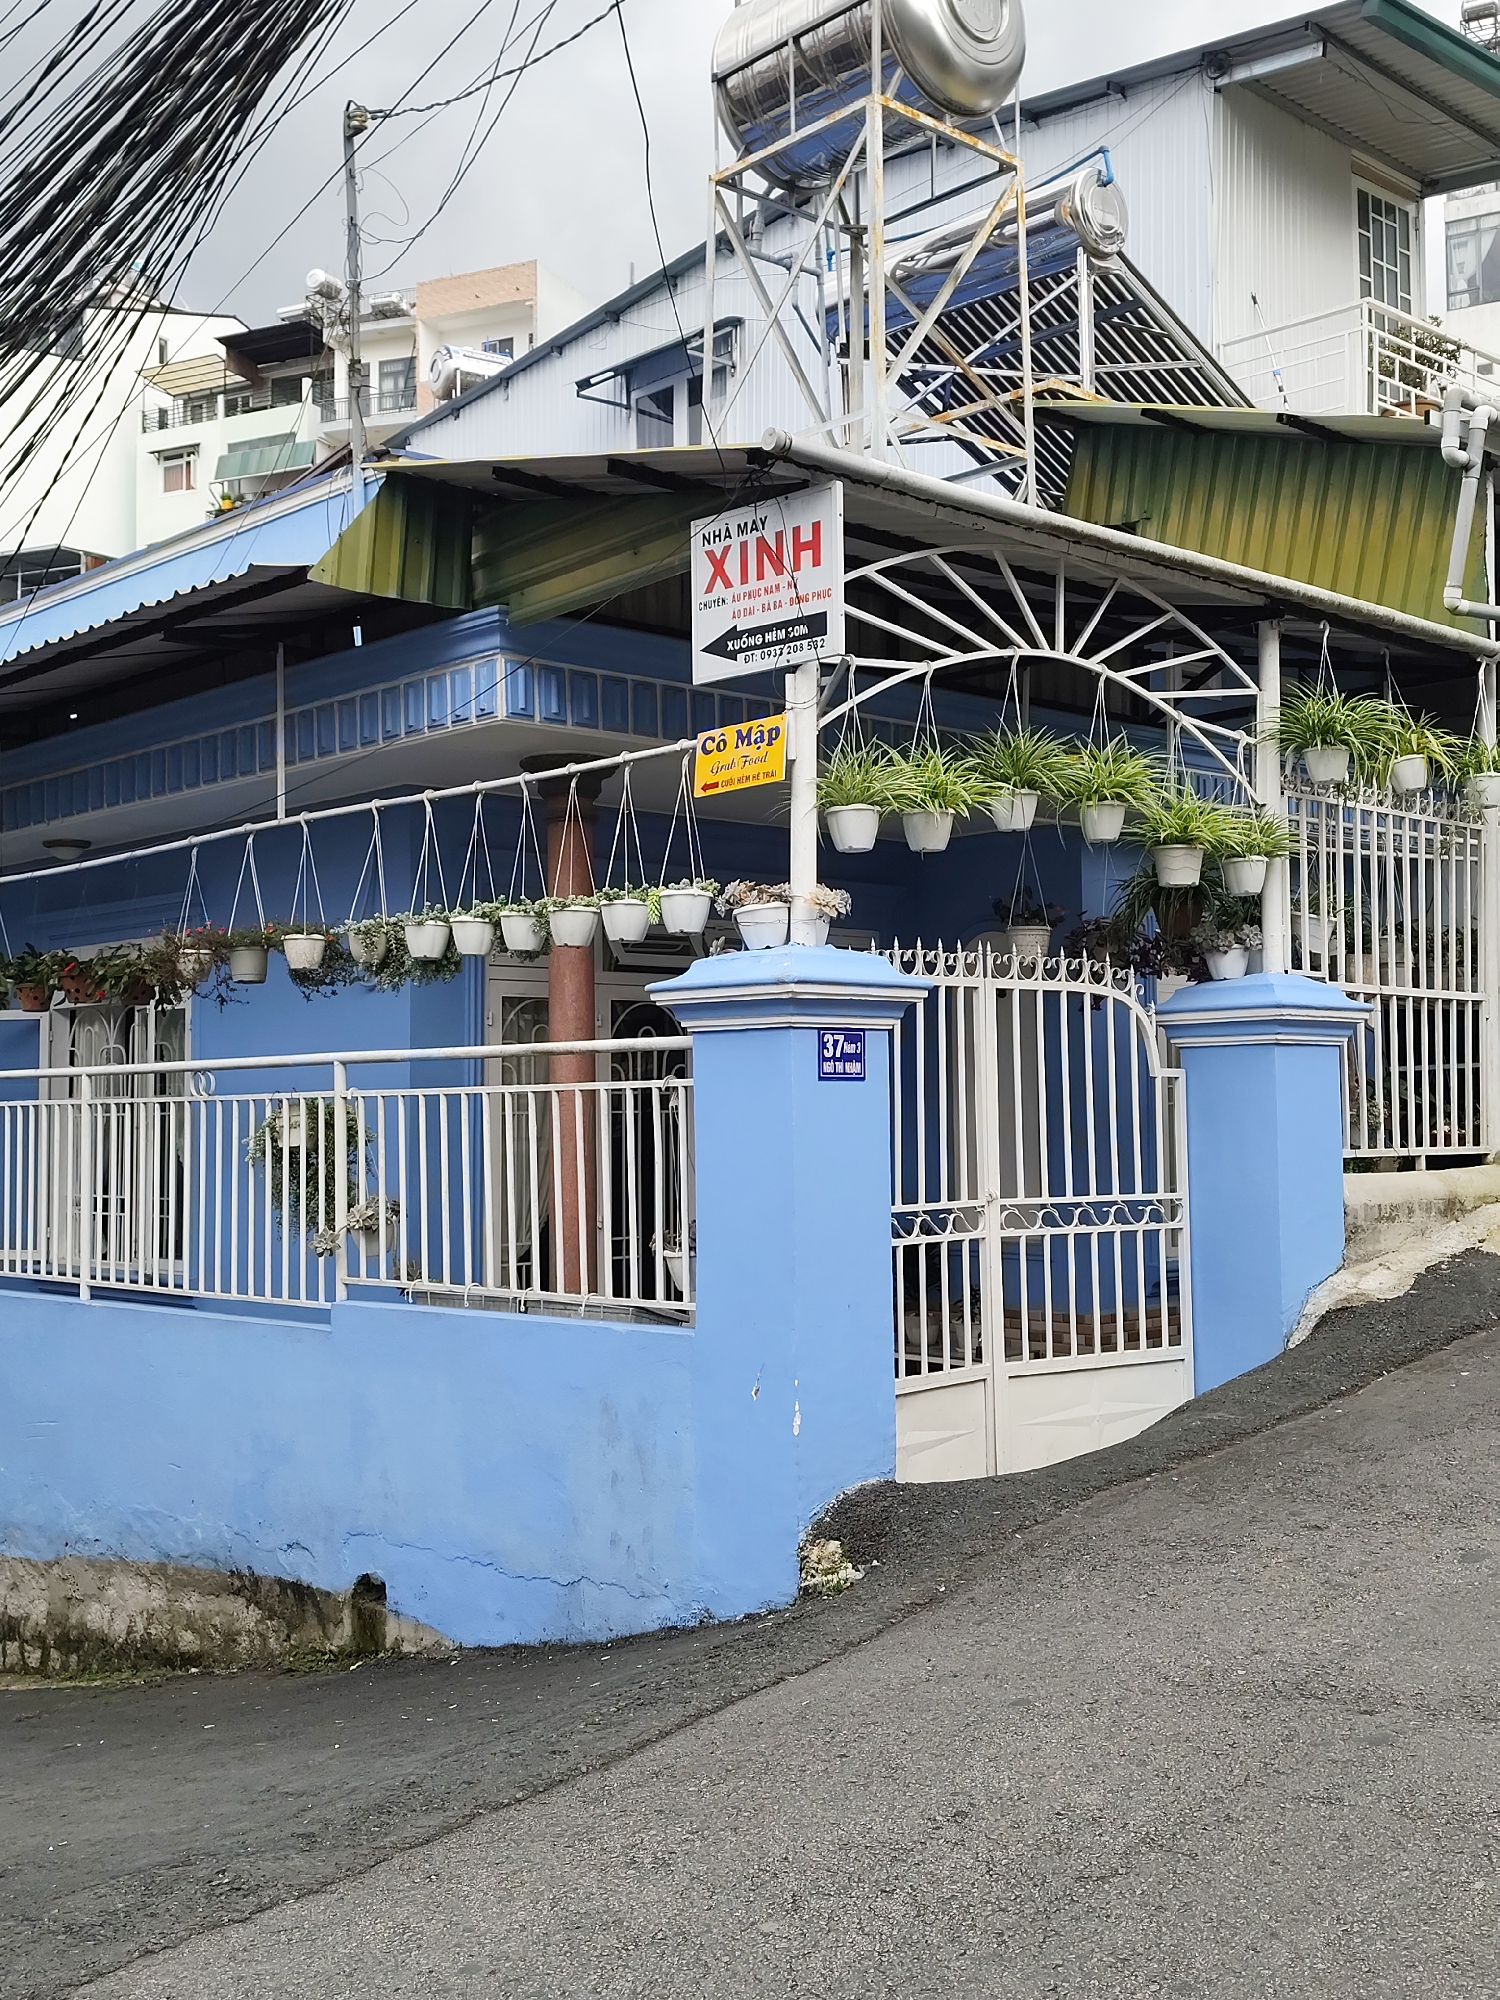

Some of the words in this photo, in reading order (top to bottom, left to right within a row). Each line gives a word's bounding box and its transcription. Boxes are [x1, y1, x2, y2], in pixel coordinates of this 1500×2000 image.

[702, 523, 732, 547] NHÀ
[737, 515, 768, 537] MAY
[704, 520, 821, 594] XINH
[742, 588, 762, 601] PHỤC
[763, 584, 781, 595] NAM
[773, 599, 783, 610] BA
[727, 633, 764, 652] XUỐNG
[743, 655, 758, 664] ĐT:
[786, 644, 805, 656] 208
[807, 638, 826, 651] 532
[701, 732, 727, 755] Cô
[734, 723, 781, 750] Mập
[738, 750, 769, 770] Food
[823, 1034, 844, 1058] 37
[856, 1041, 861, 1054] 3
